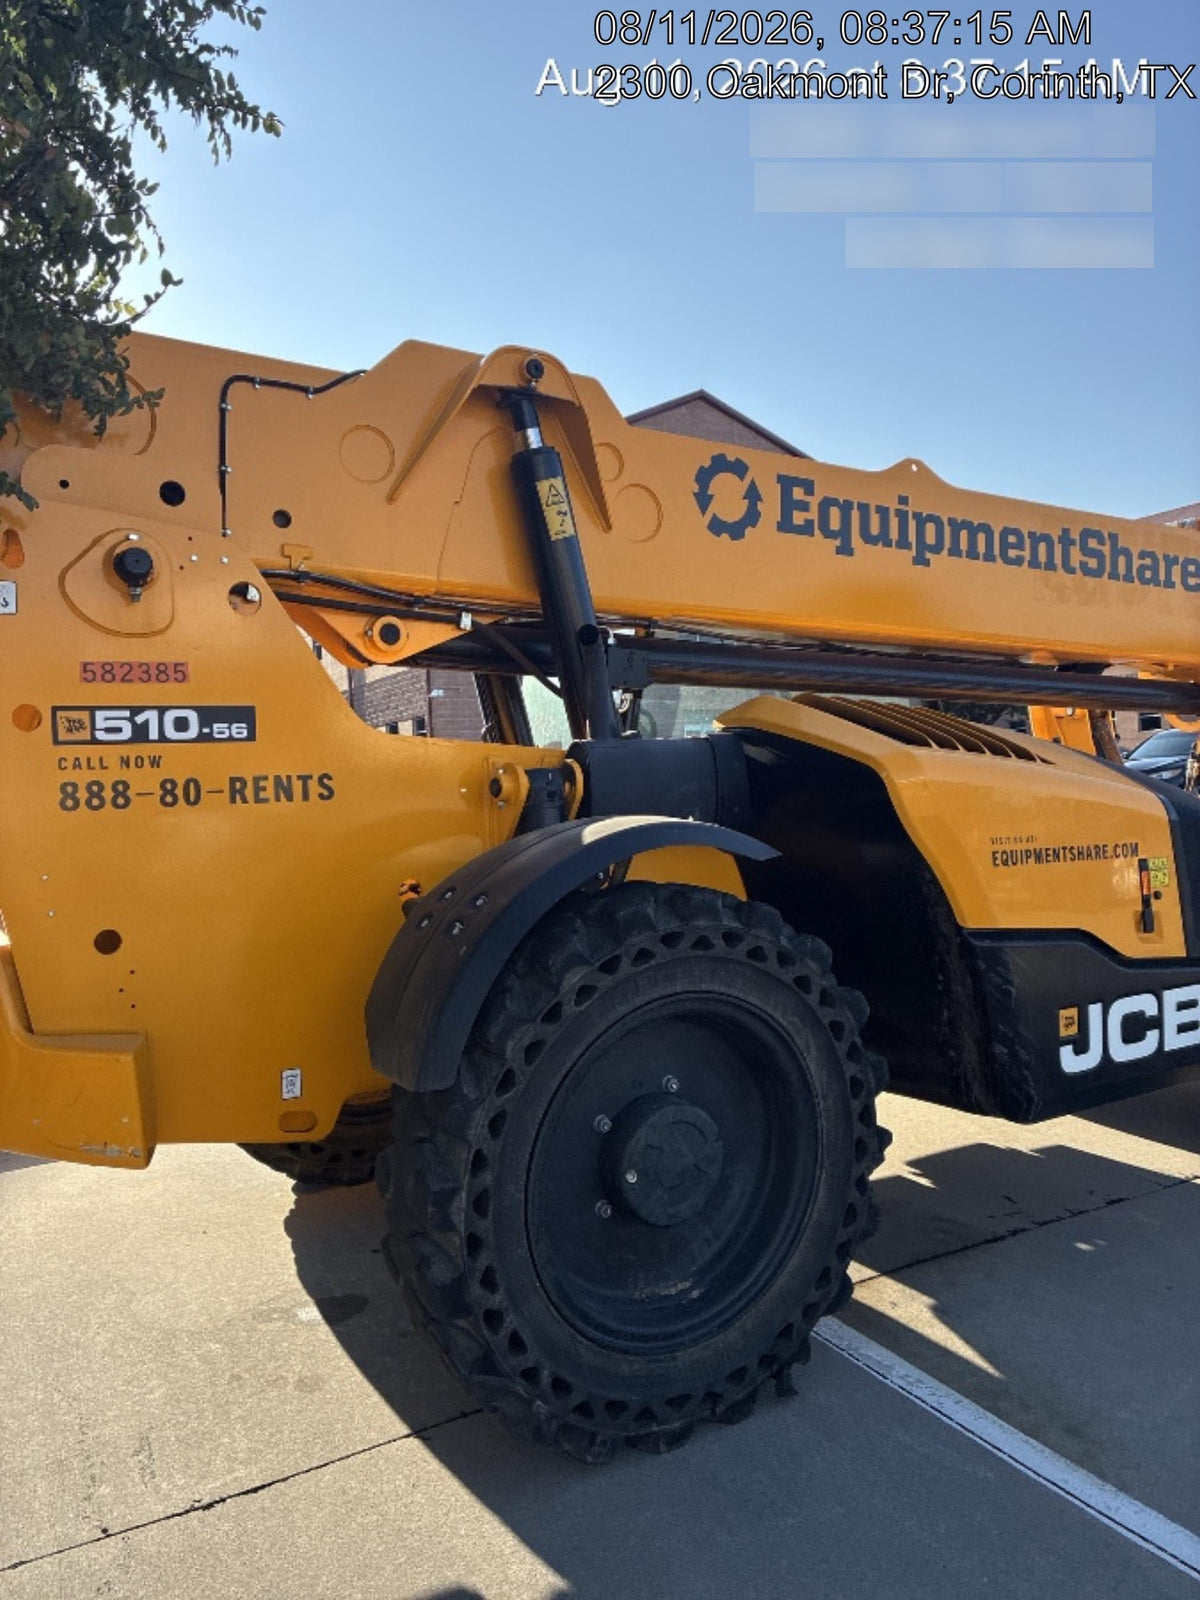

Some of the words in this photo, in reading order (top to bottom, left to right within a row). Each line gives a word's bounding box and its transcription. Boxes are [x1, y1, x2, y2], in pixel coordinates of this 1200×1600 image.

[776, 473, 1200, 593] EquipmentShare
[82, 662, 187, 683] 582385
[94, 709, 248, 741] 510-56
[58, 756, 109, 771] CALL
[120, 755, 162, 770] NOW
[58, 773, 335, 812] 888-80-RENTS
[991, 842, 1139, 868] EQUIPMENTSHARE.COM
[1059, 984, 1200, 1074] JCB
